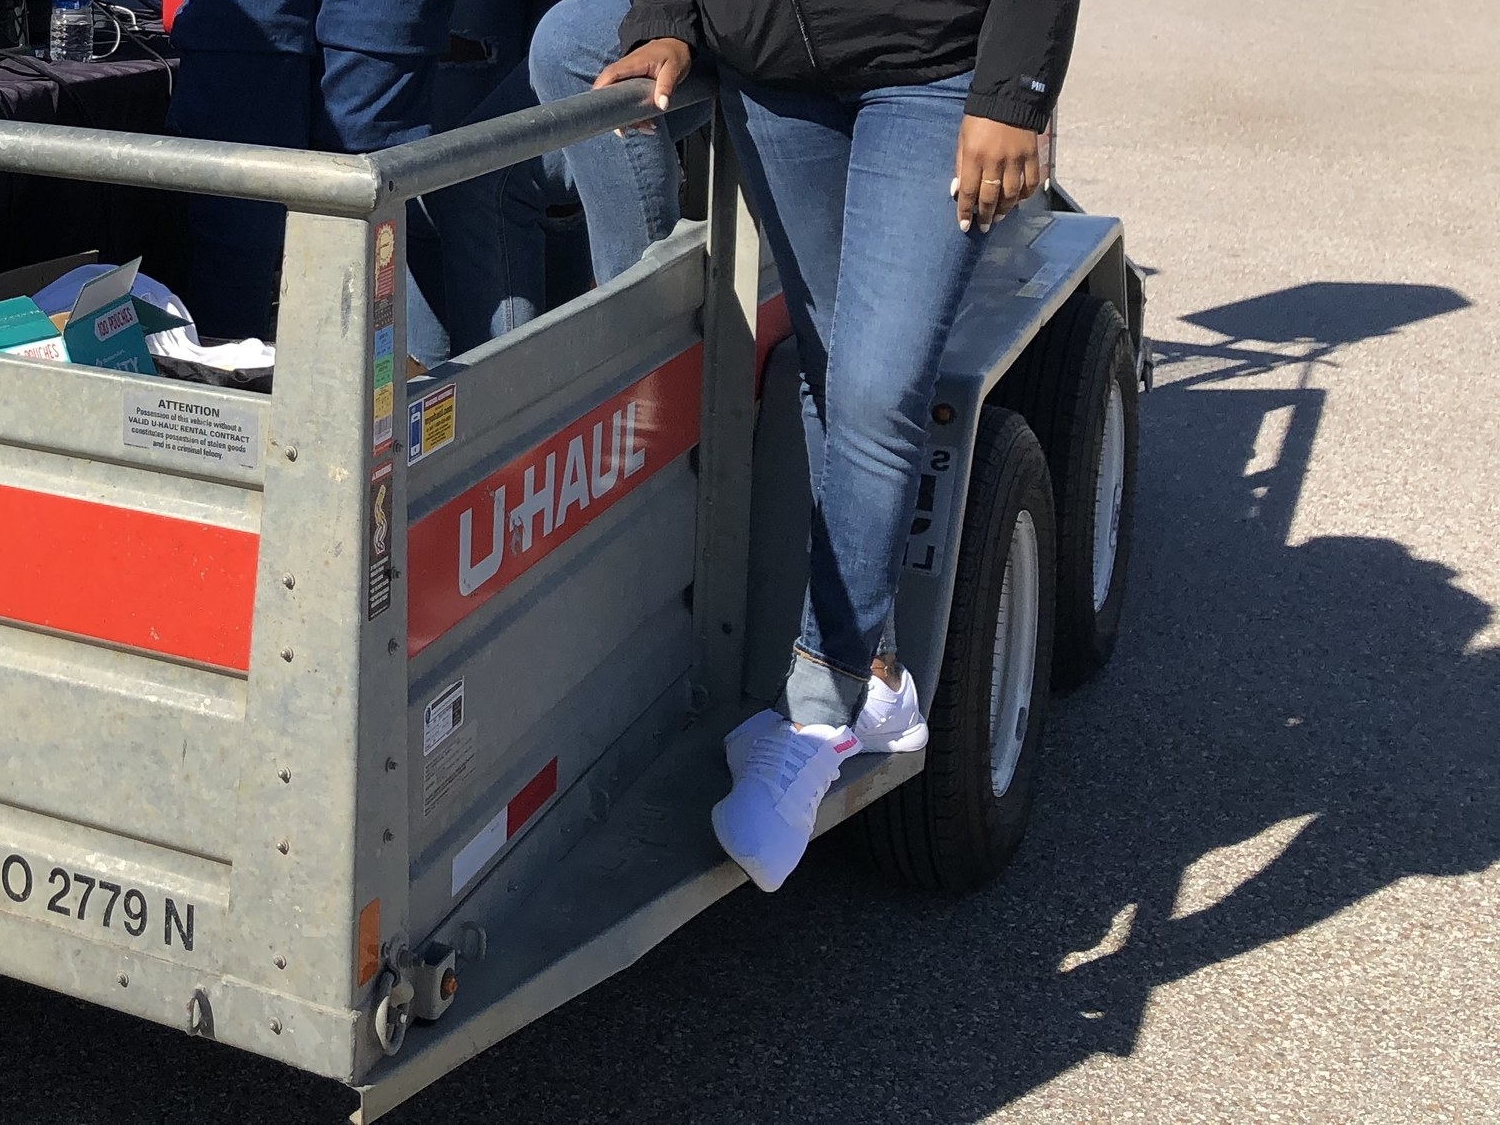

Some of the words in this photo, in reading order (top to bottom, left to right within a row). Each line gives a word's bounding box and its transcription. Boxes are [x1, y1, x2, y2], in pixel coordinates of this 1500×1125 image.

[136, 406, 169, 421] Possession
[177, 414, 189, 423] this
[190, 417, 212, 428] vehicle
[213, 421, 237, 432] without
[157, 398, 221, 418] ATTENTION
[128, 415, 150, 427] VALID
[180, 424, 208, 437] RENTAL
[209, 429, 250, 444] CONTRACT
[131, 426, 164, 439] constitutes
[165, 432, 199, 445] possession
[200, 437, 207, 446] of
[207, 439, 227, 450] stolen
[227, 443, 246, 454] goods
[152, 440, 164, 449] and
[177, 445, 202, 456] criminal
[458, 400, 646, 597] U-HAUL
[47, 866, 148, 937] 2779
[164, 897, 195, 952] N
